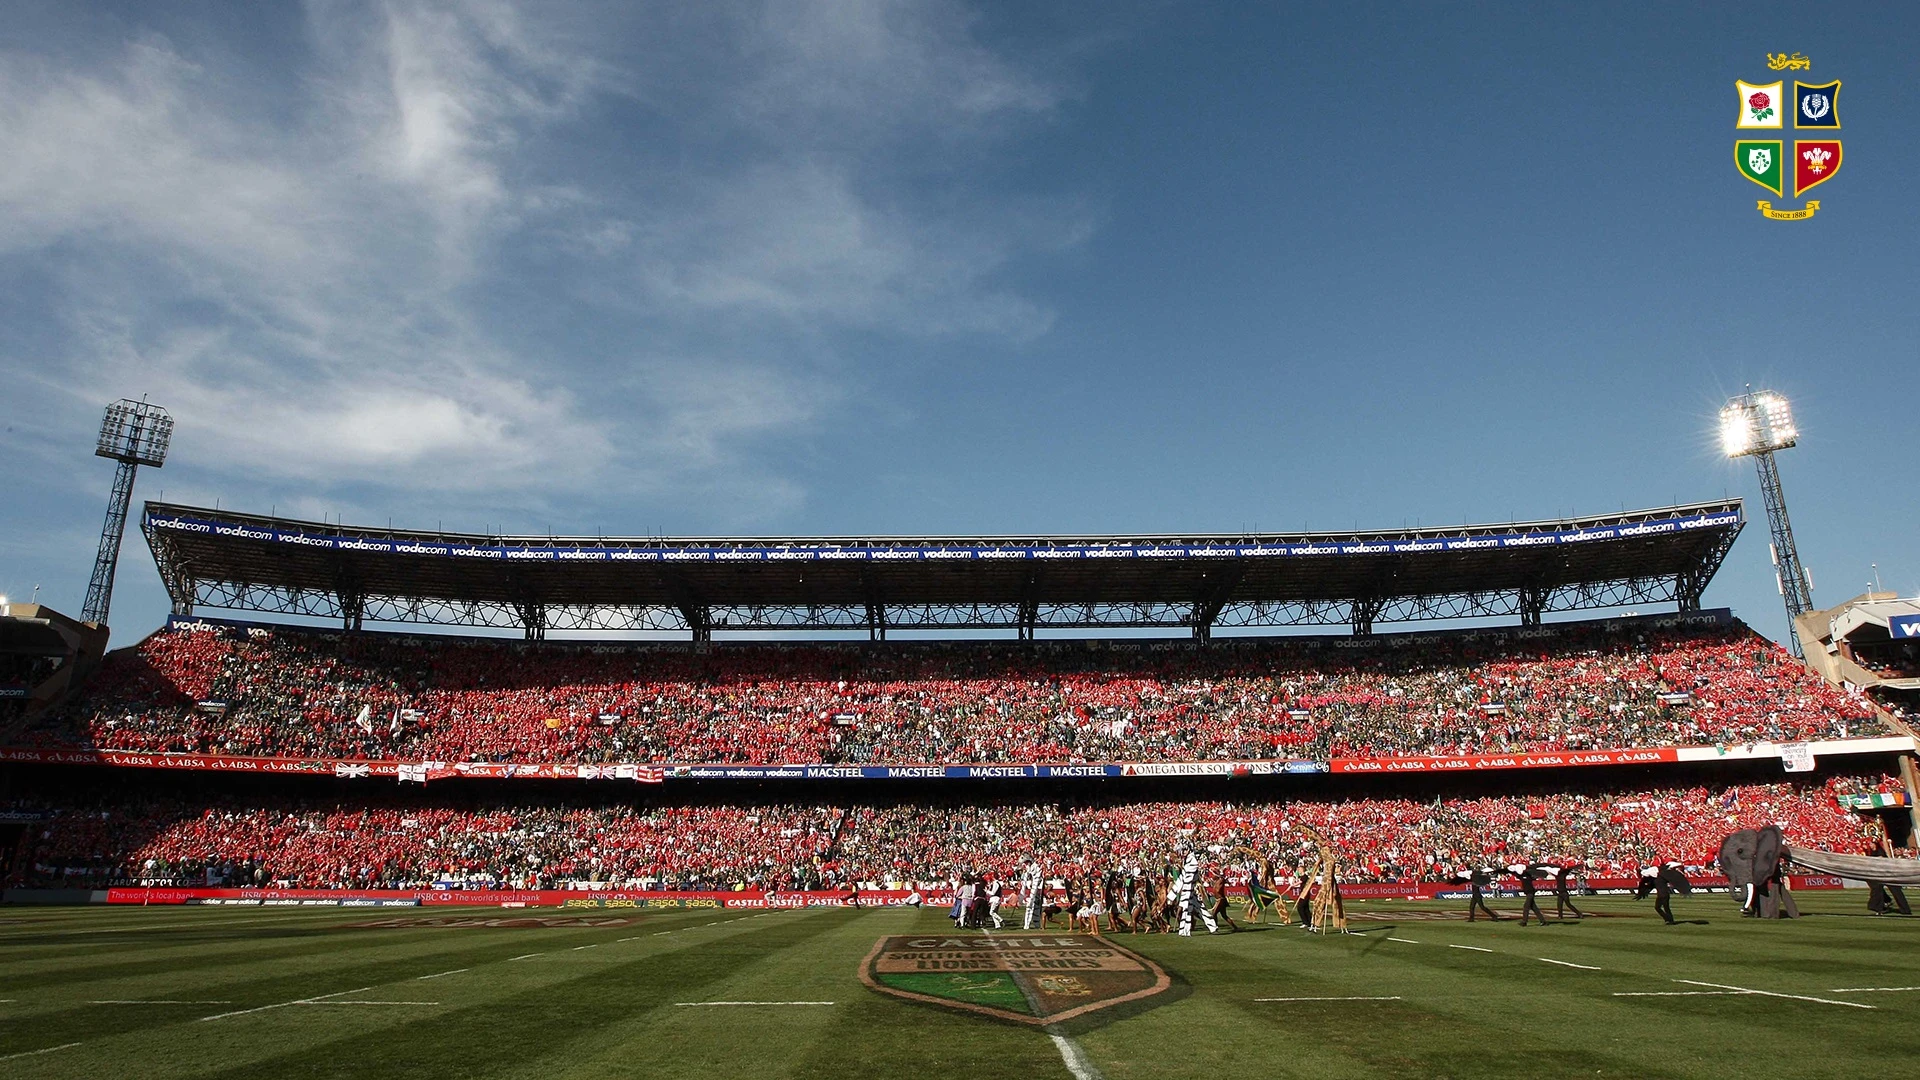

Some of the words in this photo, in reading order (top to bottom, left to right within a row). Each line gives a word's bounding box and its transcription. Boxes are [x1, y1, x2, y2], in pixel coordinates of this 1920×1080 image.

[151, 517, 210, 533] vodacom
[215, 525, 273, 540] vodacom
[278, 533, 333, 548] vodacom
[338, 539, 391, 551] vodacom
[395, 543, 447, 555] vodacom
[451, 547, 502, 558] vodacom
[506, 548, 553, 559] vodacom
[558, 548, 606, 560] vodacom
[610, 549, 658, 560] vodacom
[662, 549, 710, 560] vodacom
[714, 549, 762, 560] vodacom
[766, 549, 814, 560] vodacom
[818, 548, 866, 559] vodacom
[871, 548, 919, 559] vodacom
[923, 548, 971, 559] vodacom
[977, 548, 1026, 558] vodacom
[1032, 548, 1081, 558] vodacom
[1085, 547, 1132, 558] vodacom
[1136, 547, 1184, 557] vodacom
[1188, 546, 1236, 557] vodacom
[1240, 546, 1287, 556] vodacom
[1291, 545, 1338, 555] vodacom
[1342, 543, 1389, 554] vodacom
[1393, 541, 1442, 551] vodacom
[1447, 537, 1499, 549] vodacom
[1503, 534, 1555, 546] vodacom
[1559, 530, 1614, 543] vodacom
[1618, 522, 1674, 537] vodacom
[1679, 515, 1737, 529] vodacom
[1584, 755, 1610, 763] ABSA
[9, 752, 41, 761] ABSA
[66, 755, 98, 763] ABSA
[122, 757, 153, 765] ABSA
[176, 759, 206, 768] ABSA
[228, 761, 257, 770] ABSA
[559, 768, 577, 776] BSA
[1136, 765, 1177, 774] OMEGA
[1179, 764, 1204, 774] RISK
[1207, 763, 1270, 774] SOLONS
[726, 768, 763, 777] vodacom
[765, 768, 803, 777] vodacom
[808, 768, 864, 777] MACSTEEL
[888, 768, 945, 777] MACSTEEL
[970, 767, 1026, 776] MACSTEEL
[1050, 766, 1106, 776] MACSTEEL
[1804, 878, 1828, 886] HSBC
[111, 890, 126, 899] The
[127, 890, 155, 899] world's
[156, 890, 175, 899] local
[1350, 887, 1378, 895] world's
[455, 893, 469, 901] The
[470, 893, 499, 901] world's
[521, 893, 540, 901] bank
[907, 938, 1083, 948] CASTLE
[1056, 950, 1114, 958] 2009
[916, 960, 998, 969] LIONS
[1005, 959, 1103, 969] SERIES
